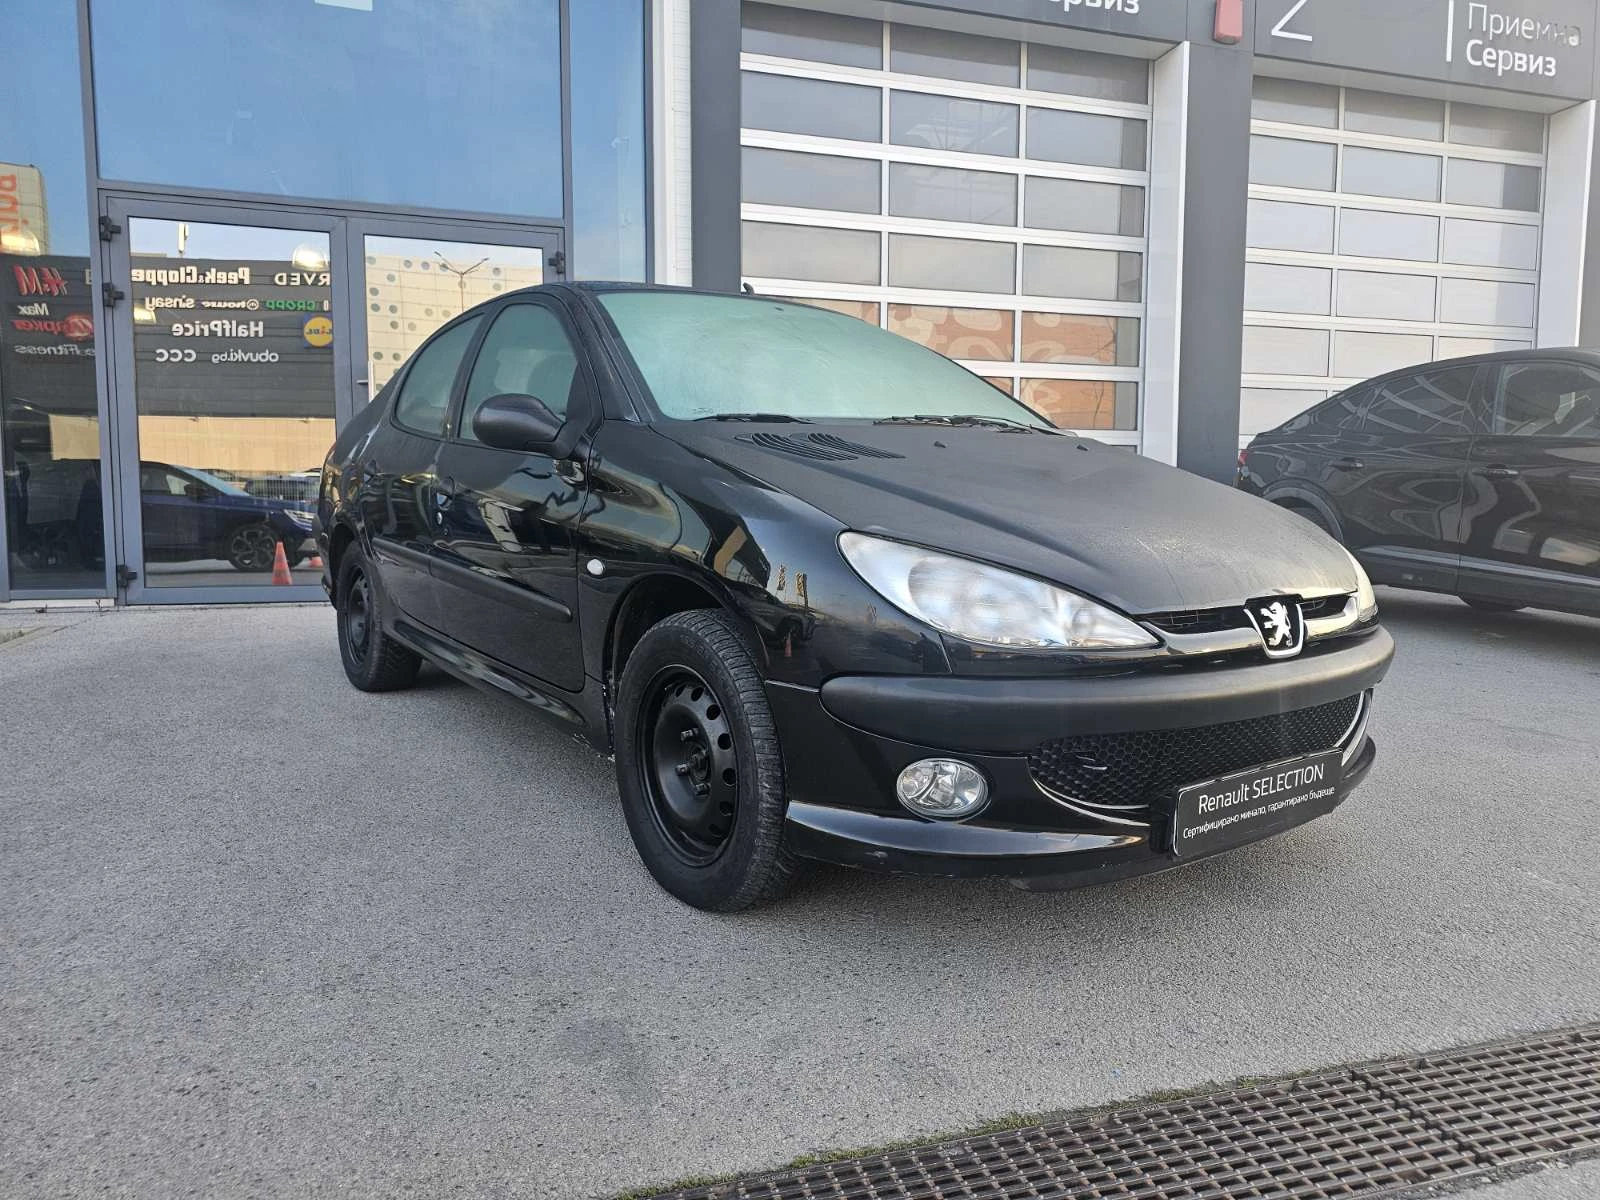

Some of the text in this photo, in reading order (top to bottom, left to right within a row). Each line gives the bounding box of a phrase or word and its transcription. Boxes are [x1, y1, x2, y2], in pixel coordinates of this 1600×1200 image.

[1466, 39, 1557, 77] Сервиз
[1198, 763, 1324, 814] Renault SELECTION
[1183, 812, 1239, 839] Сертифицирано
[1267, 793, 1308, 815] гарантирано
